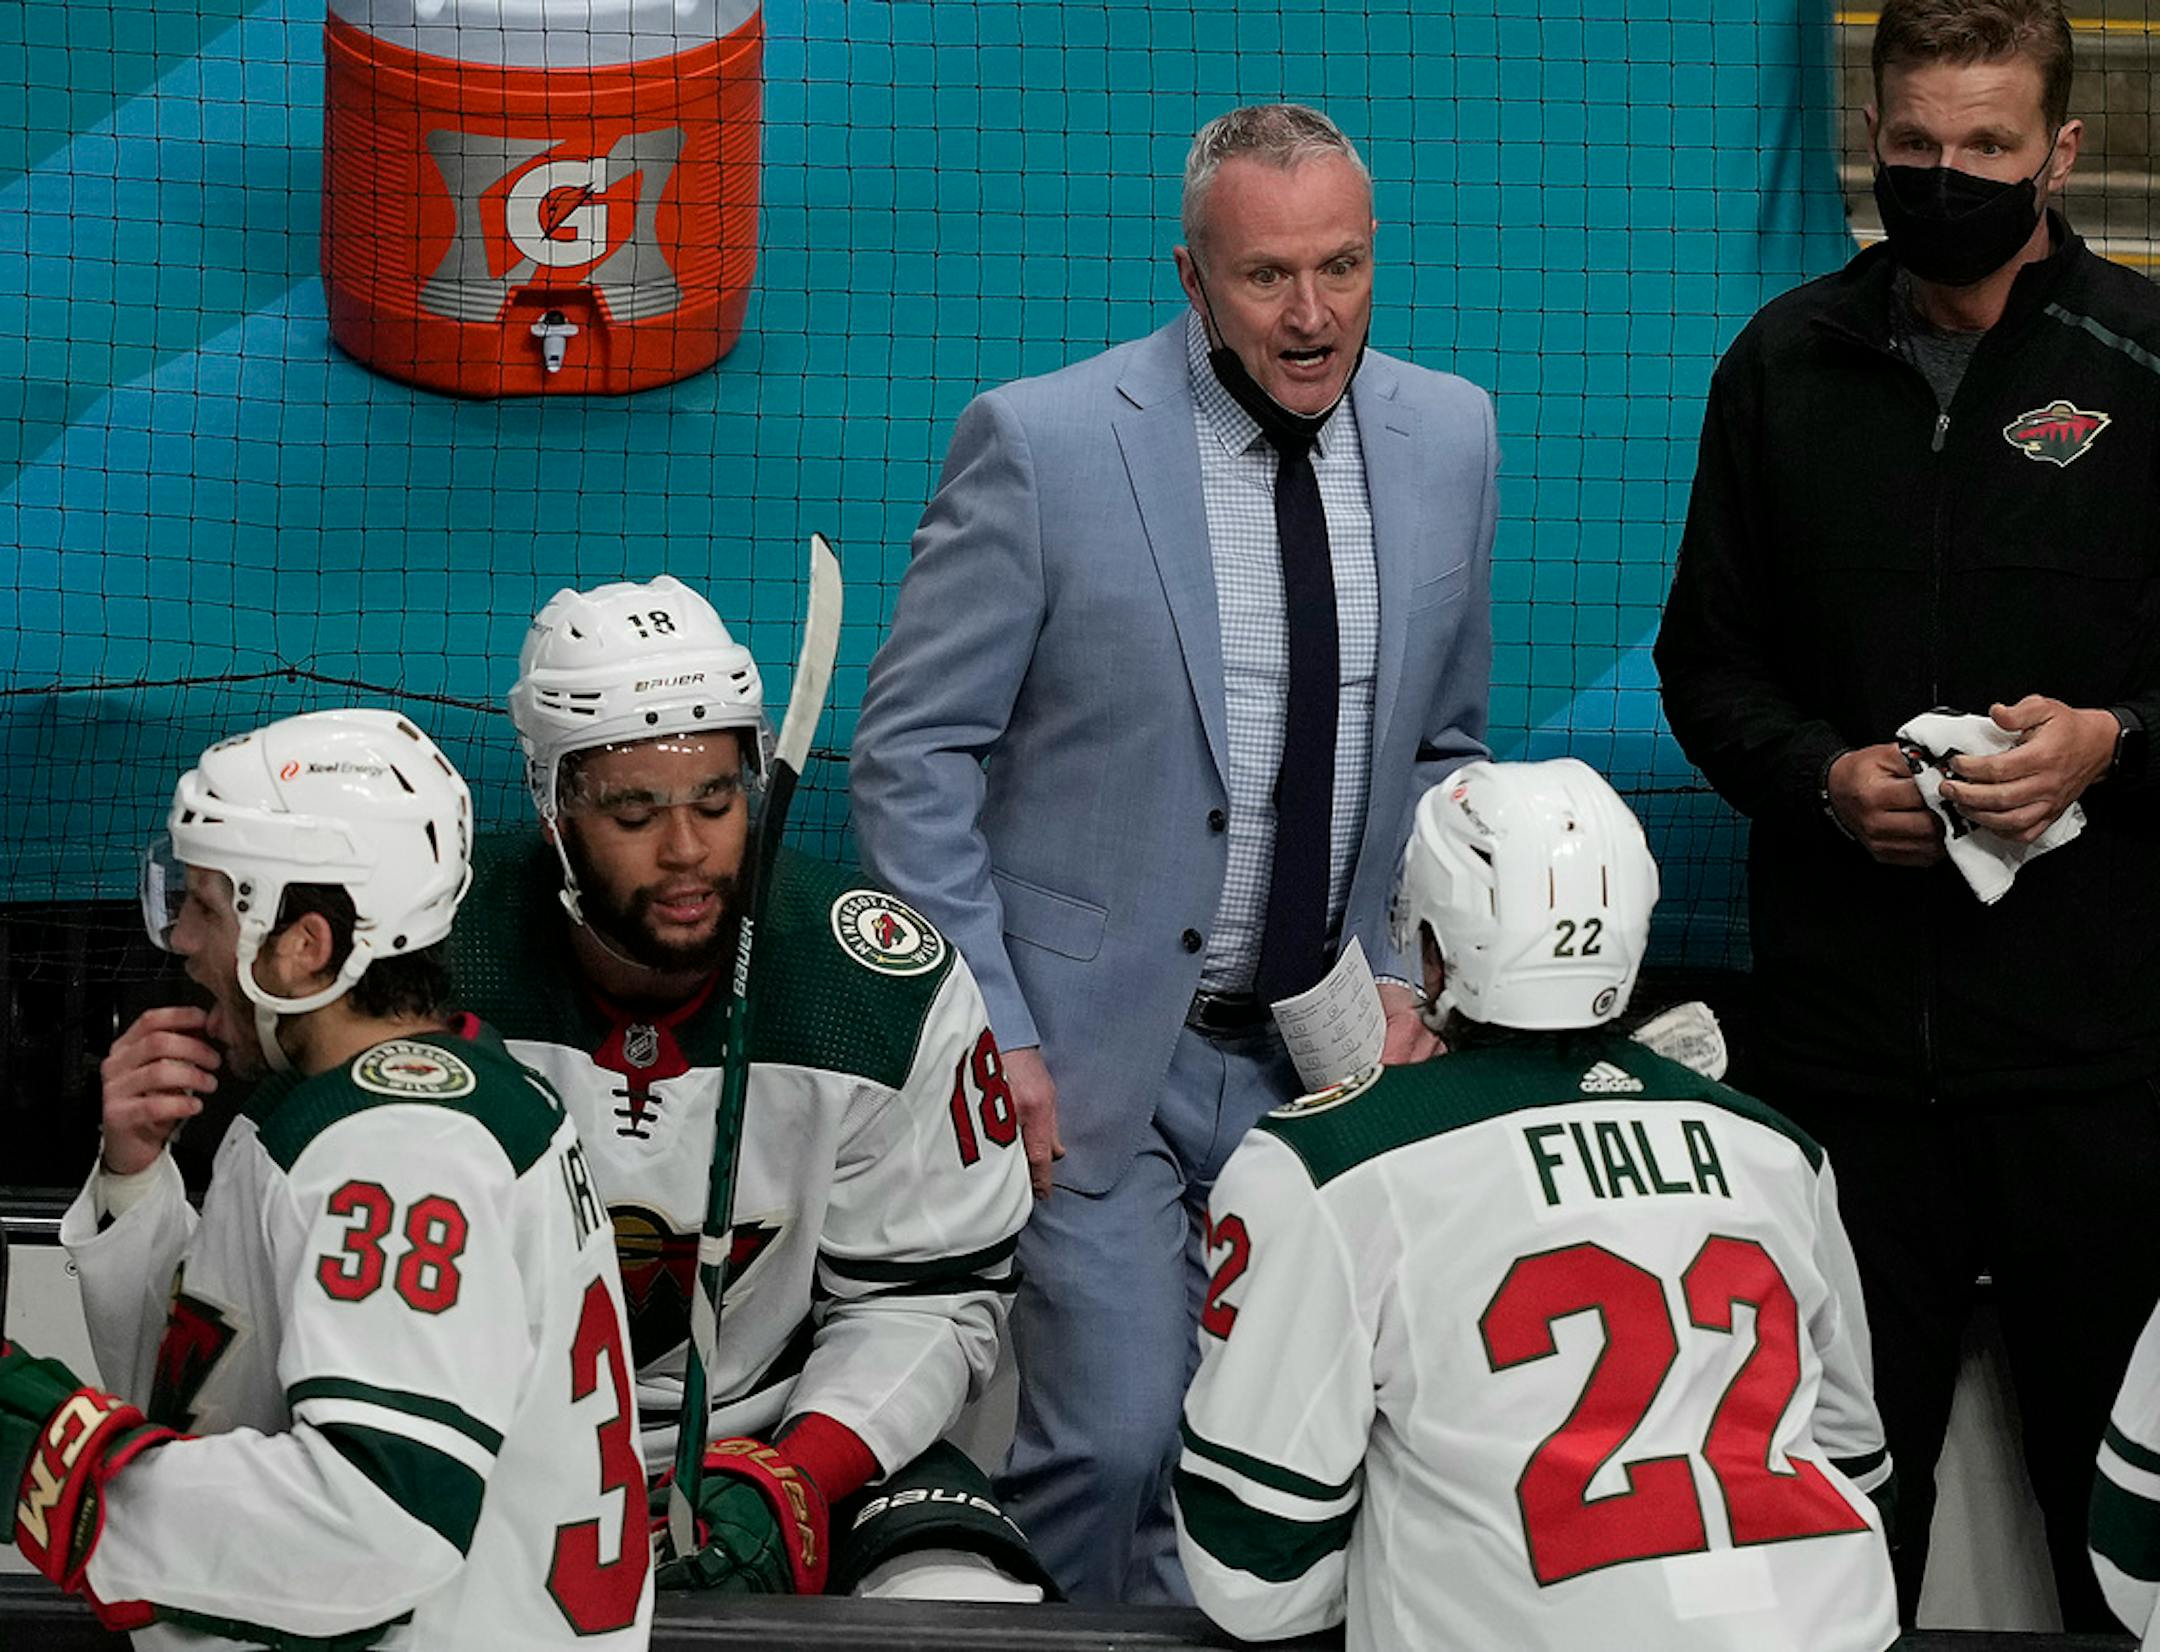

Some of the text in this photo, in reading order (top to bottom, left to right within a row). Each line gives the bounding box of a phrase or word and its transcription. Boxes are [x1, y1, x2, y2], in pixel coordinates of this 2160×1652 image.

[506, 157, 608, 268] G
[628, 610, 676, 638] 18
[634, 673, 705, 692] BAUER
[732, 916, 754, 998] BAUER
[1553, 917, 1604, 958] 22
[949, 1025, 1018, 1169] 18
[1523, 1119, 1732, 1206] FIALA
[316, 1179, 470, 1315] 38
[1202, 1208, 1252, 1343] 2
[1478, 1232, 1873, 1588] 22
[17, 1396, 122, 1549] CM
[706, 1439, 817, 1567] AUER
